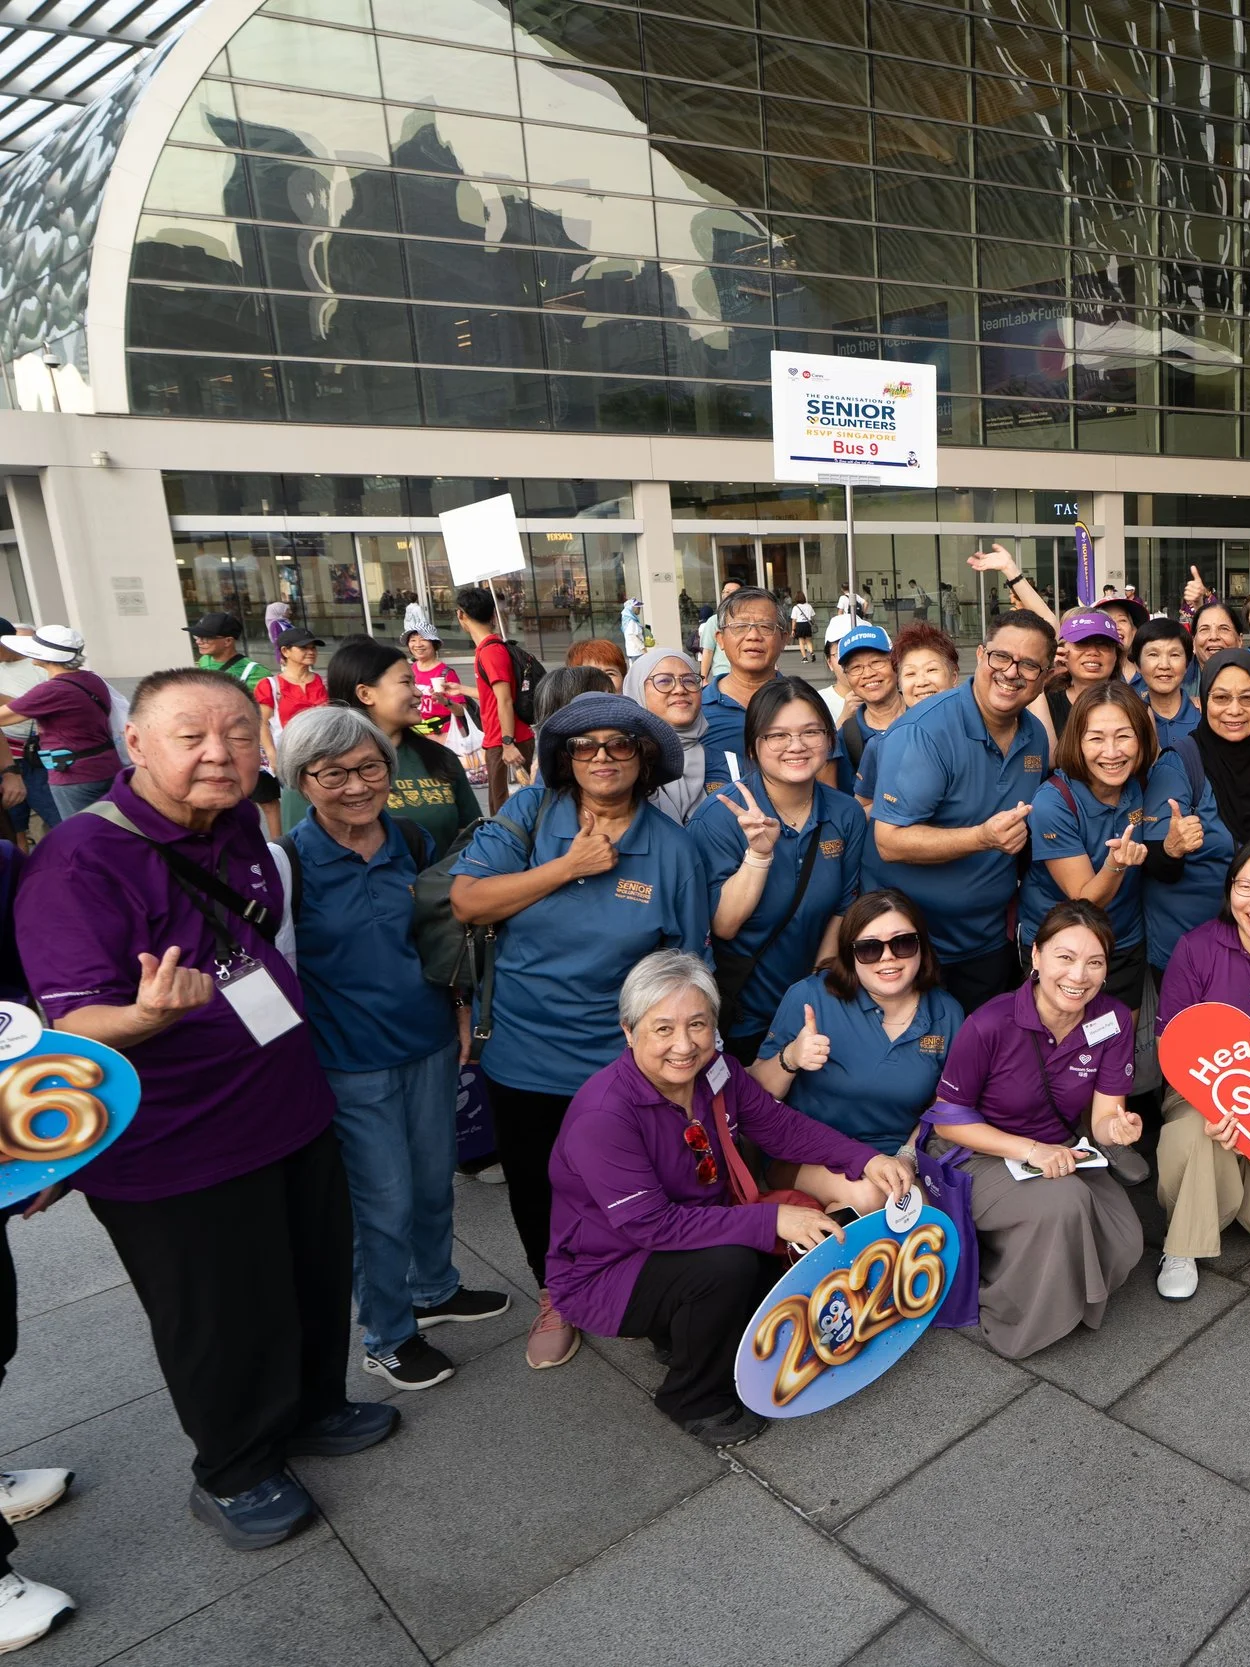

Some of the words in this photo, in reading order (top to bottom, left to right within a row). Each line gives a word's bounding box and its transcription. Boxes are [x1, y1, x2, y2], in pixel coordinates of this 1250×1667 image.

[824, 394, 883, 404] ORGANISATION
[806, 399, 896, 421] SENIOR
[836, 431, 896, 441] SINGAPORE
[833, 440, 864, 455] Bus
[869, 442, 879, 456] 9
[851, 632, 877, 642] BEYOND
[395, 779, 414, 790] OF
[617, 881, 653, 895] SENIOR
[752, 1223, 946, 1407] 2026
